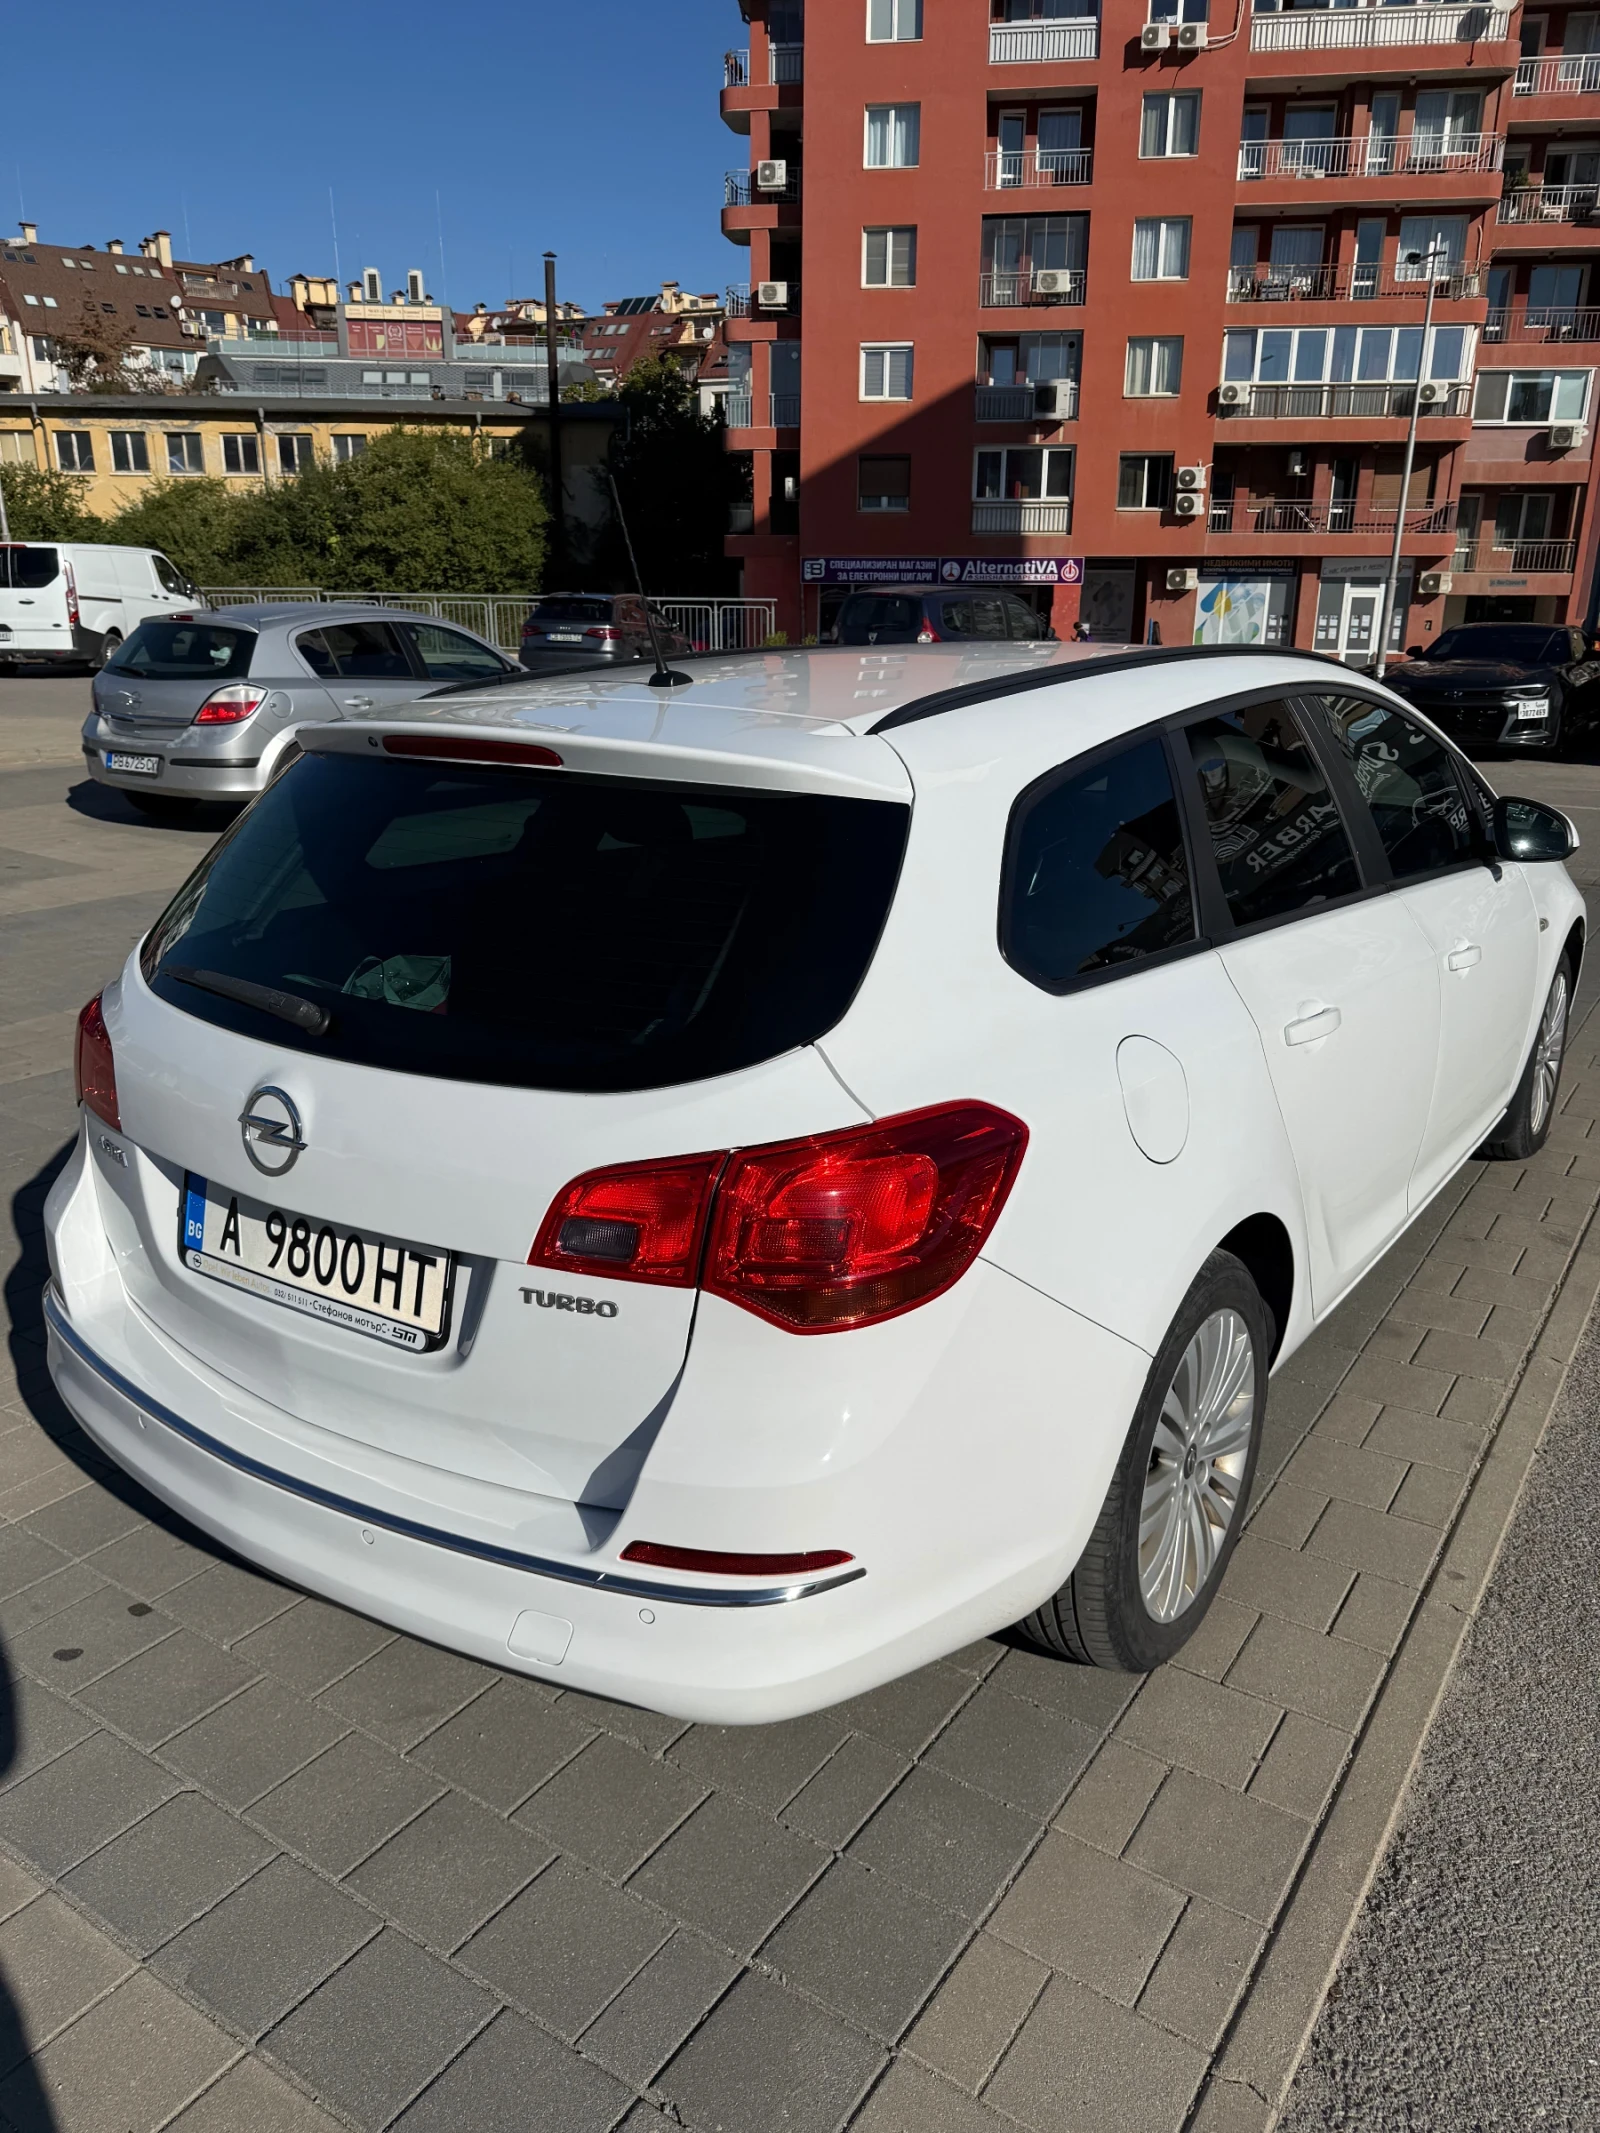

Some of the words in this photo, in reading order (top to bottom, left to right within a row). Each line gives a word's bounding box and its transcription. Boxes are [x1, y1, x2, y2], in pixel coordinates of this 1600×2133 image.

[829, 560, 897, 570] СПЕЦИАЛИЗИРАН
[898, 560, 936, 570] МАГАЗИН
[964, 560, 1058, 575] AlternatiVA
[1203, 559, 1261, 567] НЕДВИЖИМИ
[1263, 559, 1294, 567] ИМОТИ
[836, 572, 848, 581] ЗА
[849, 571, 899, 581] ЕЛЕКТРОННИ
[900, 572, 933, 582] ЦИГАРИ
[187, 1219, 203, 1240] BG
[219, 1196, 242, 1257] A
[265, 1210, 365, 1295] 9800
[373, 1241, 437, 1317] HT
[518, 1286, 619, 1318] TURBO
